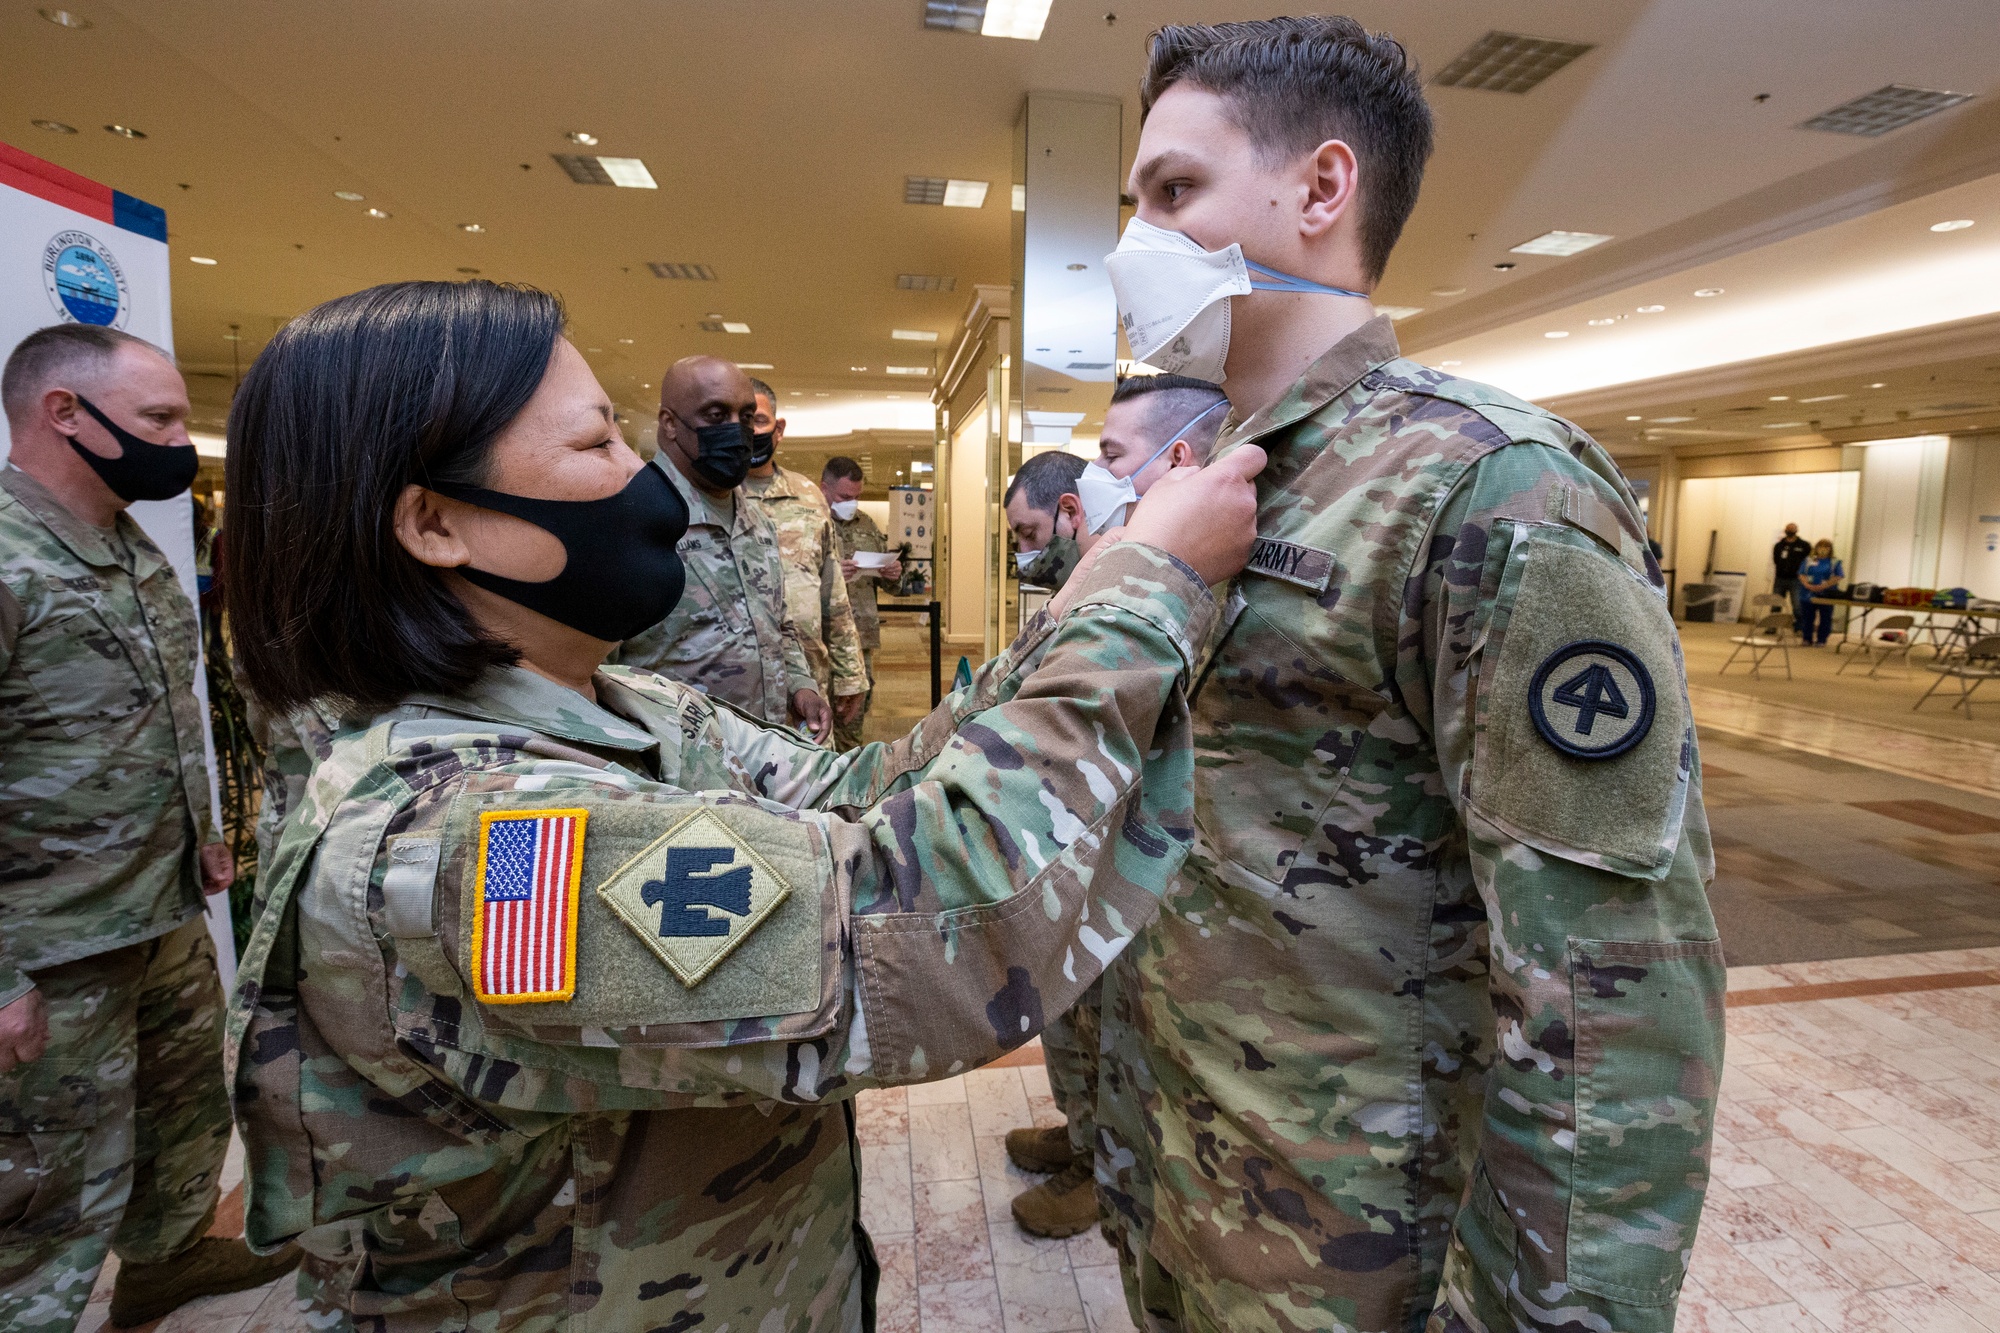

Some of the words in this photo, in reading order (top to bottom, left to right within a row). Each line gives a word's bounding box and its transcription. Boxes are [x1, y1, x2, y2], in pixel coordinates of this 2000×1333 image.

[45, 233, 92, 273] BURLINGTON
[98, 247, 127, 294] COUNTY
[1249, 541, 1308, 575] ARMY
